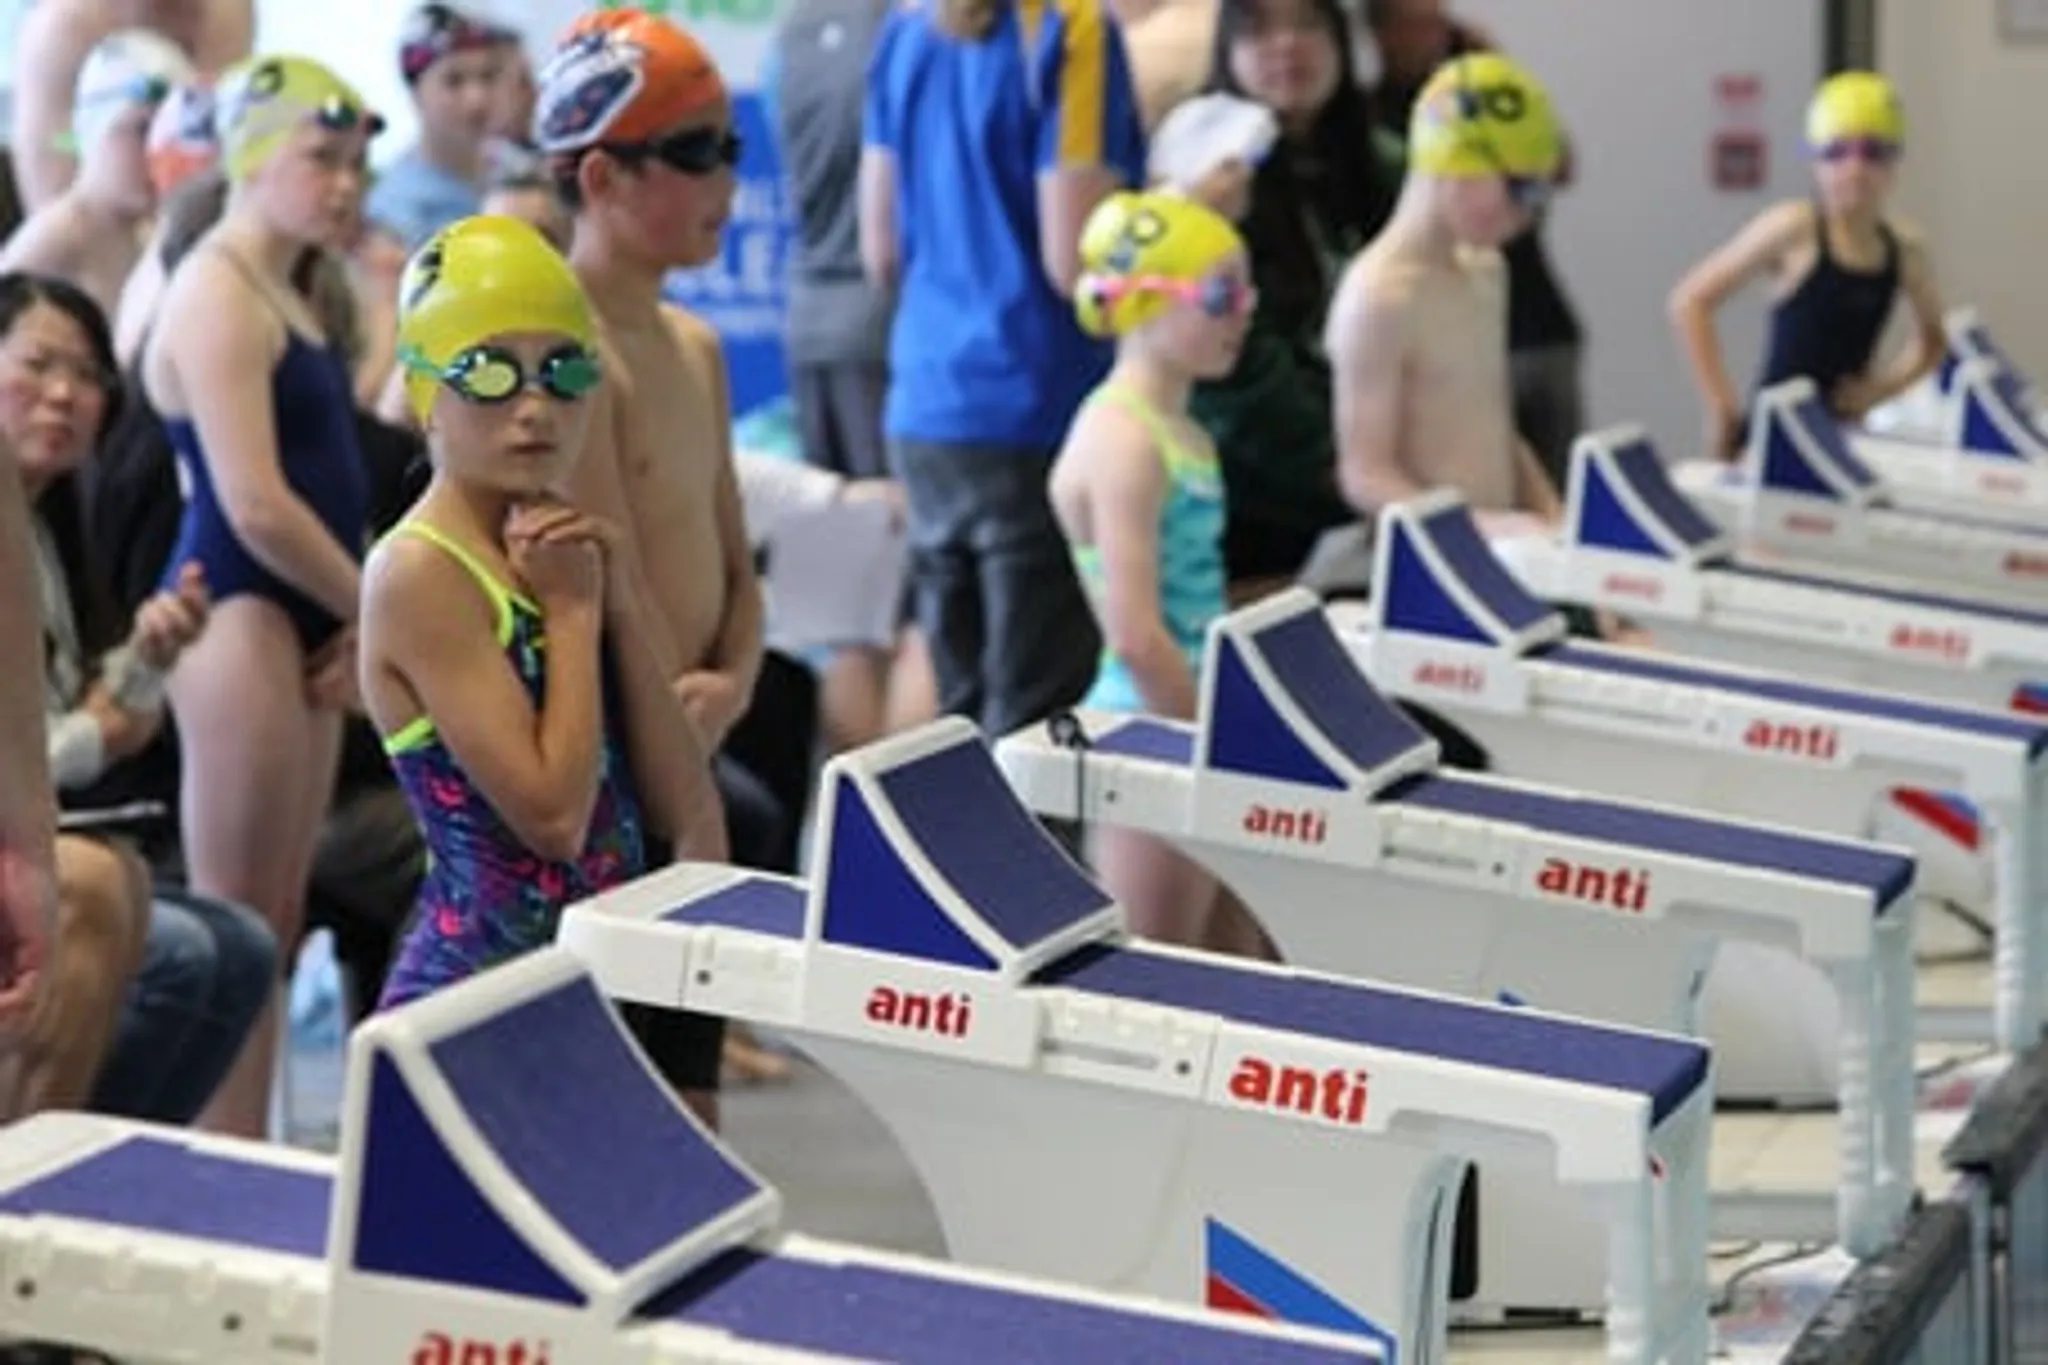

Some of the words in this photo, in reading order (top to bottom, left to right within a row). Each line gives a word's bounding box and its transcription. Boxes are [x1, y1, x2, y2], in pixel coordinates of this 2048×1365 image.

[1743, 717, 1839, 758] anti
[1243, 805, 1326, 844] anti
[1536, 857, 1650, 911] anti
[865, 986, 971, 1037] anti
[1228, 1056, 1368, 1125] anti
